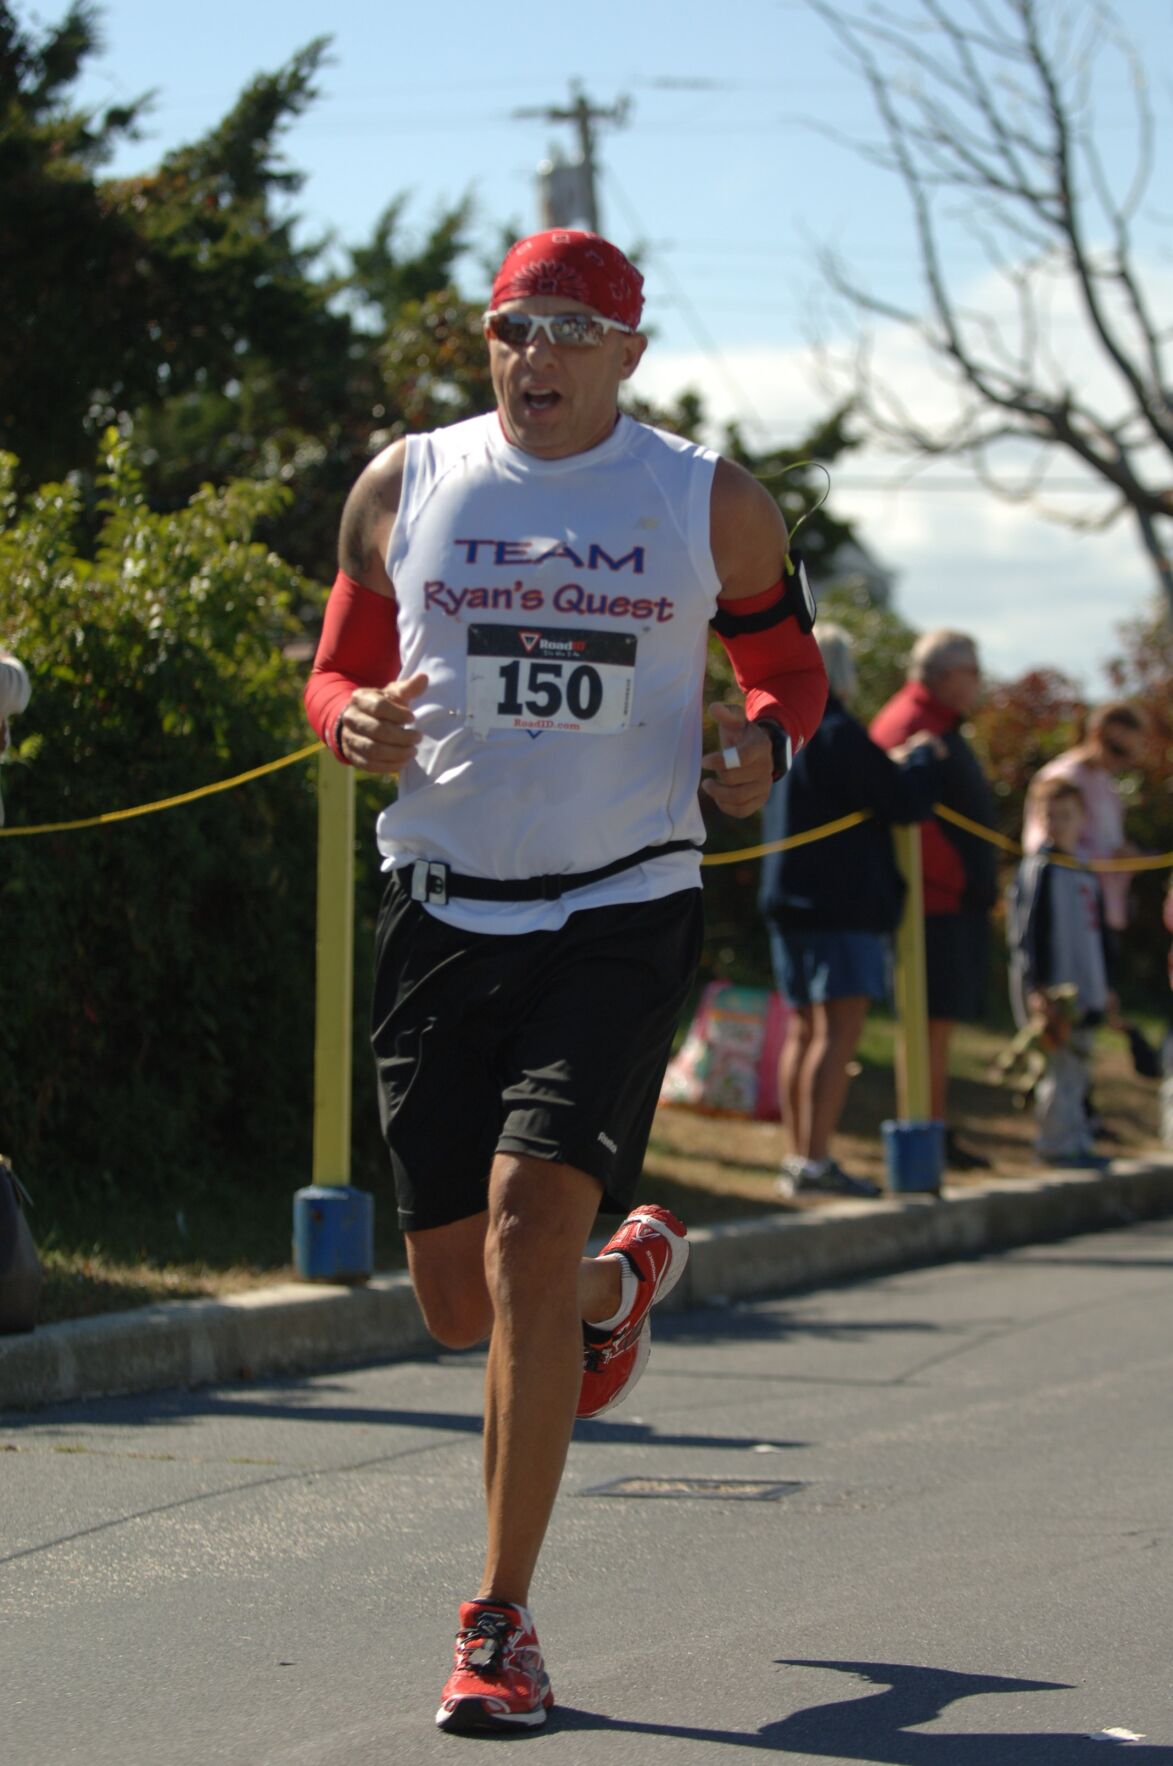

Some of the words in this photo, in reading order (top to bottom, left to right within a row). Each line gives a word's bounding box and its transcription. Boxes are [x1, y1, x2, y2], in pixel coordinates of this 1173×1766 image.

[454, 539, 645, 574] TEAM
[423, 580, 544, 616] Ryan's
[553, 583, 674, 623] Quest
[497, 660, 603, 720] 150
[513, 719, 580, 730] RoadID.com
